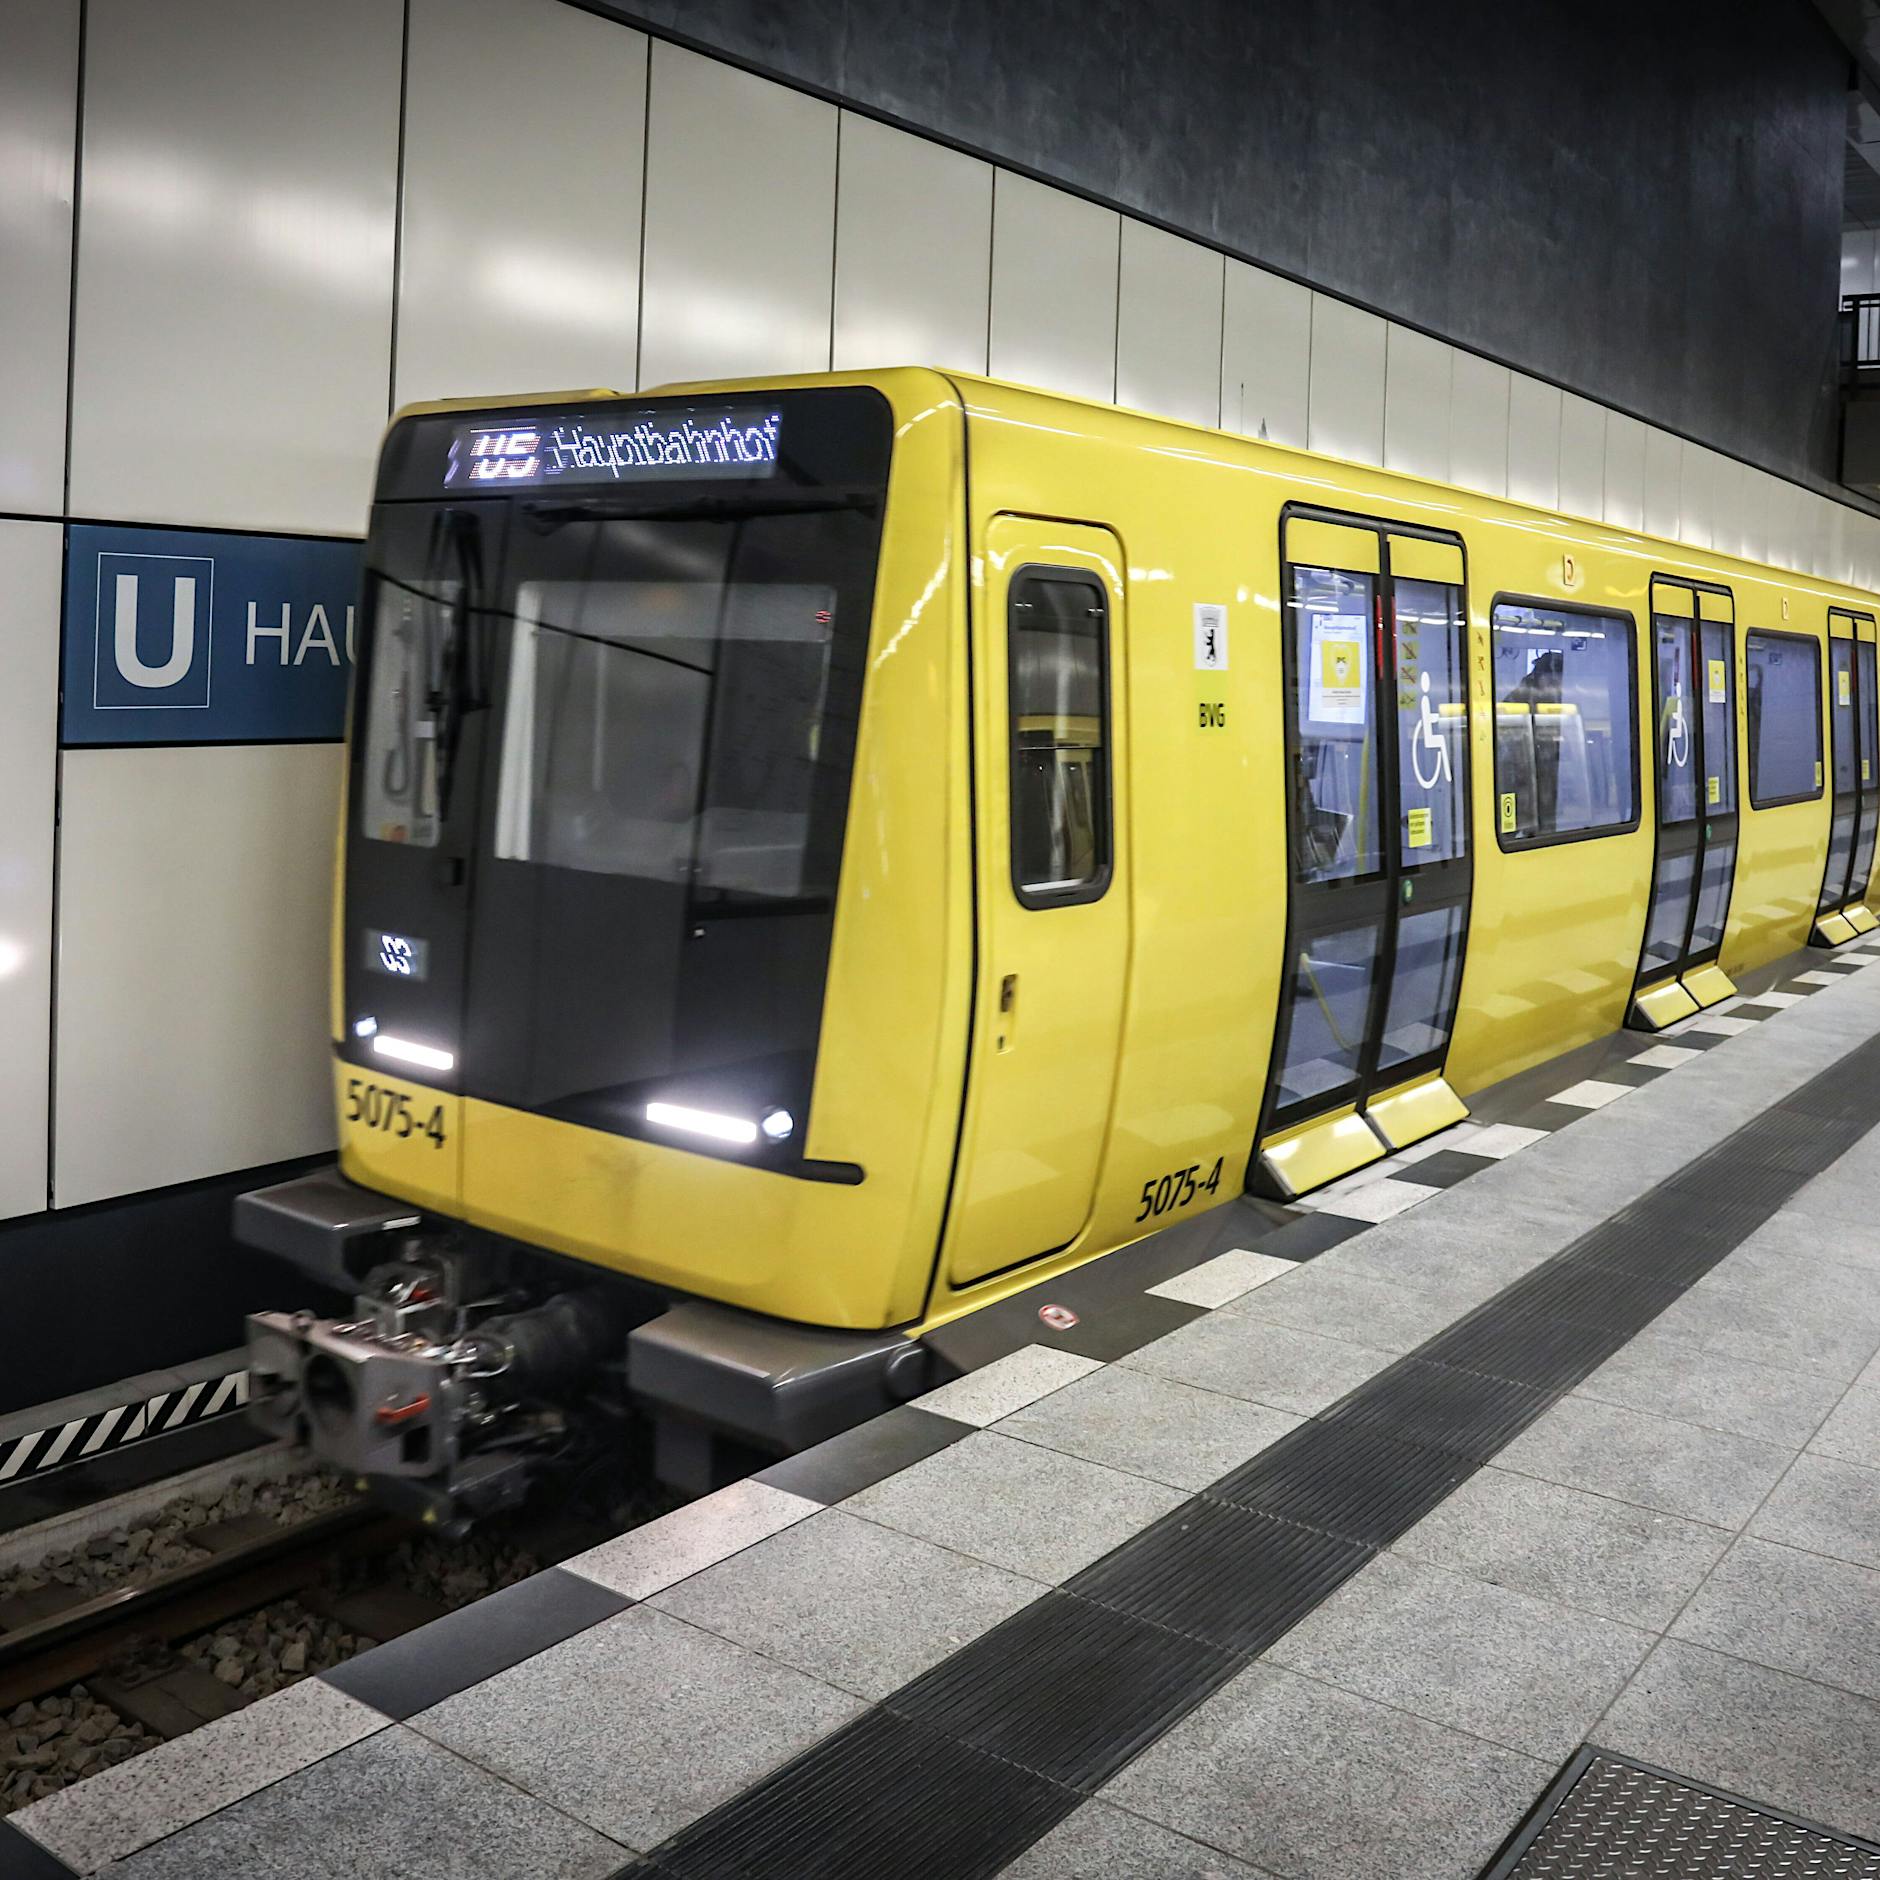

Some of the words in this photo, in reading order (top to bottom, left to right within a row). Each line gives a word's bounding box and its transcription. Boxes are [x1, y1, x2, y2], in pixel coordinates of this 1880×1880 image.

[552, 415, 780, 478] Hauptbahnhof
[114, 574, 196, 688] U
[1199, 702, 1226, 728] BVG
[346, 1078, 446, 1150] 5075-4
[1135, 1156, 1225, 1223] 5075-4
